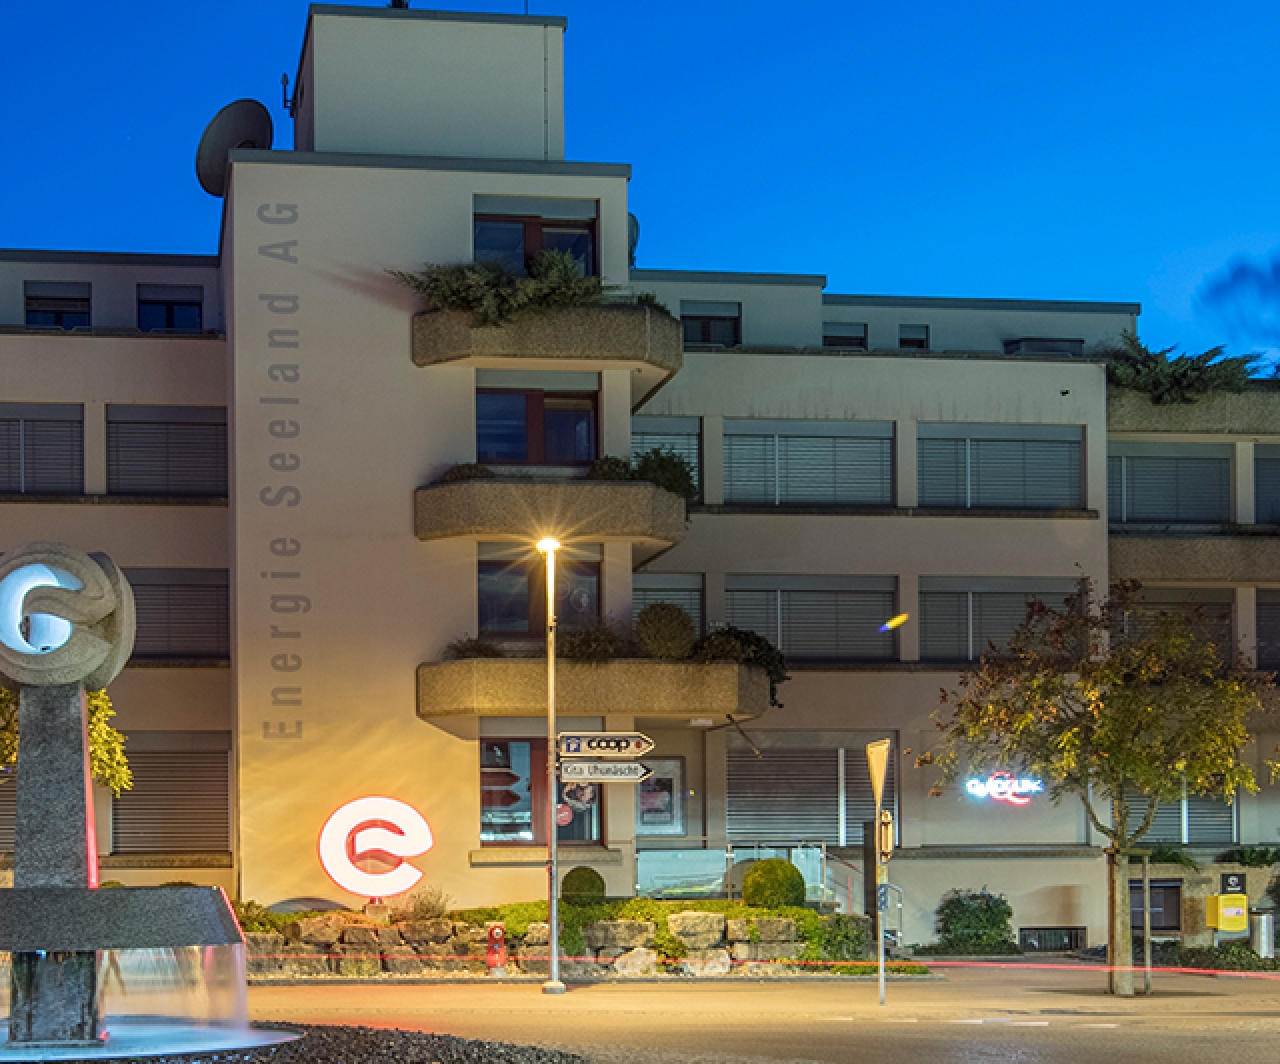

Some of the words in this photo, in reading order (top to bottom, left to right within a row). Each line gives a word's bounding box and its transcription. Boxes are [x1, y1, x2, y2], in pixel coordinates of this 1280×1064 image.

[257, 203, 299, 264] AG
[258, 294, 301, 508] Seeland
[260, 537, 312, 740] Energie
